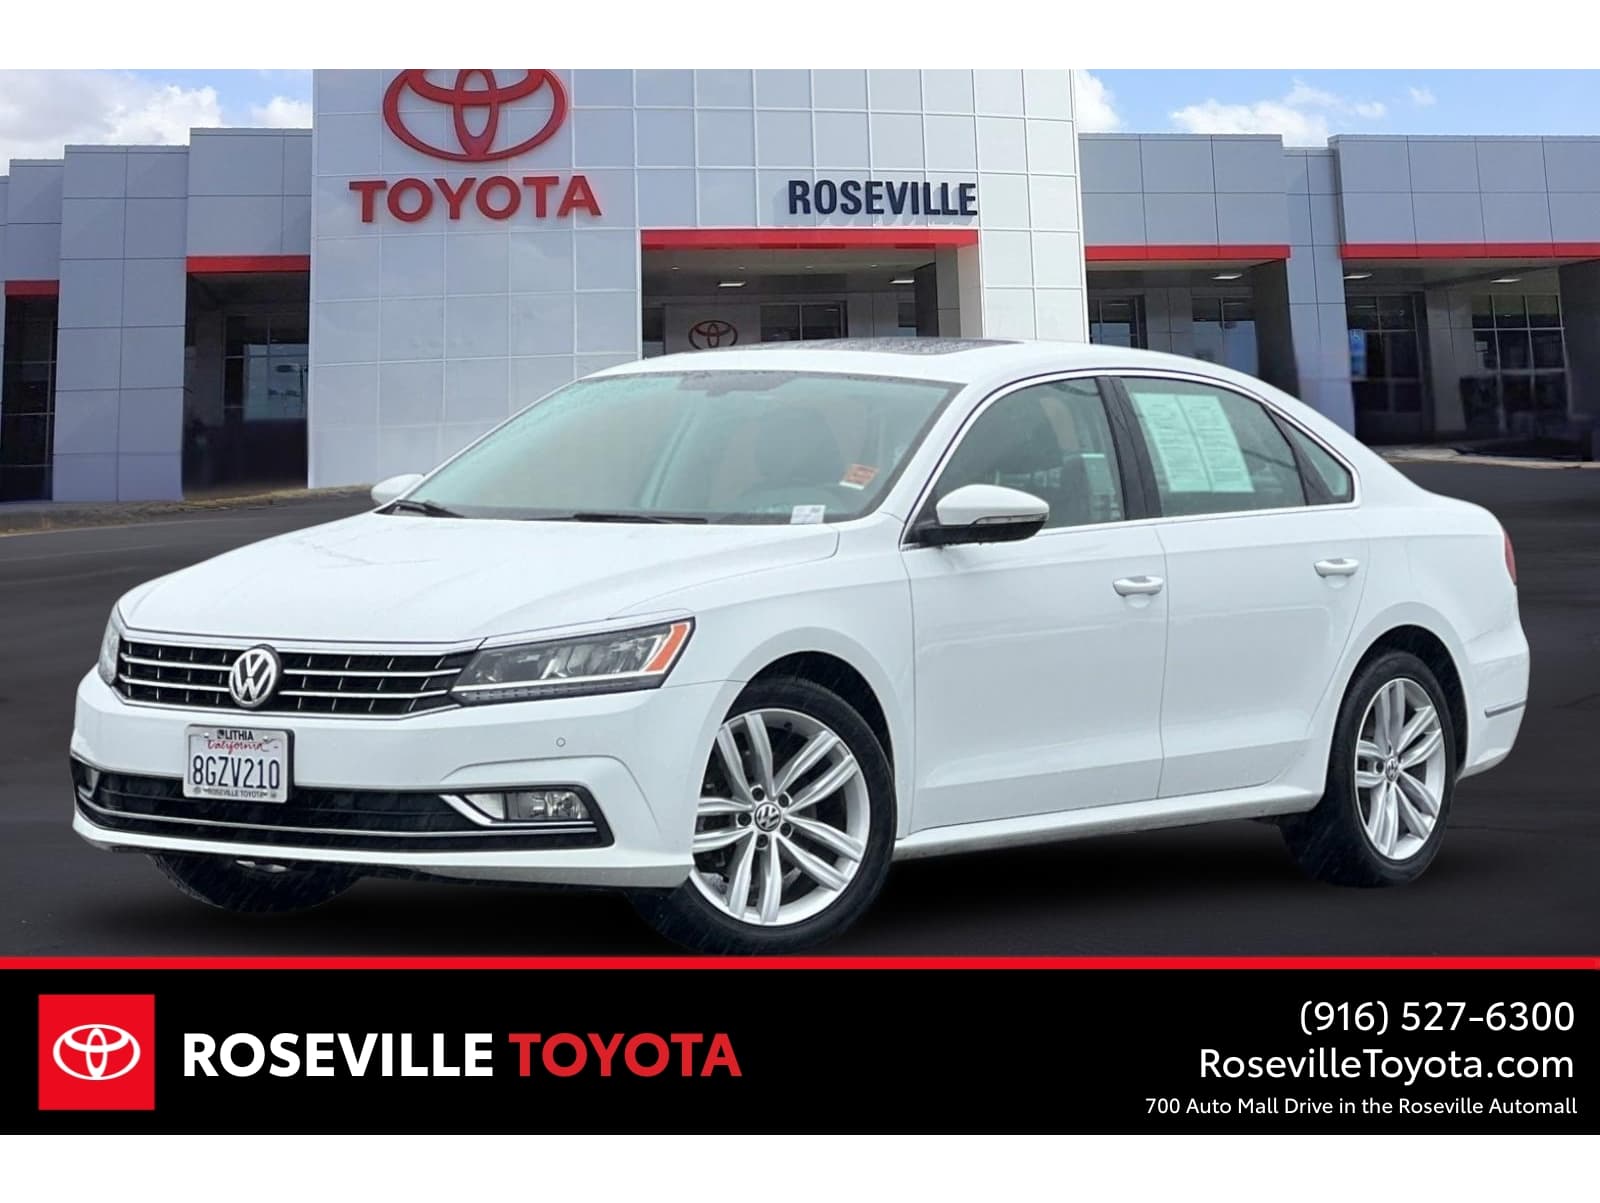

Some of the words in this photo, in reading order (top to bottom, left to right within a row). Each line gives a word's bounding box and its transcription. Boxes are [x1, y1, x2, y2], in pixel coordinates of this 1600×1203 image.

[349, 175, 602, 223] TOYOTA
[788, 179, 979, 217] ROSEVILLE
[193, 755, 280, 790] 8GZV210
